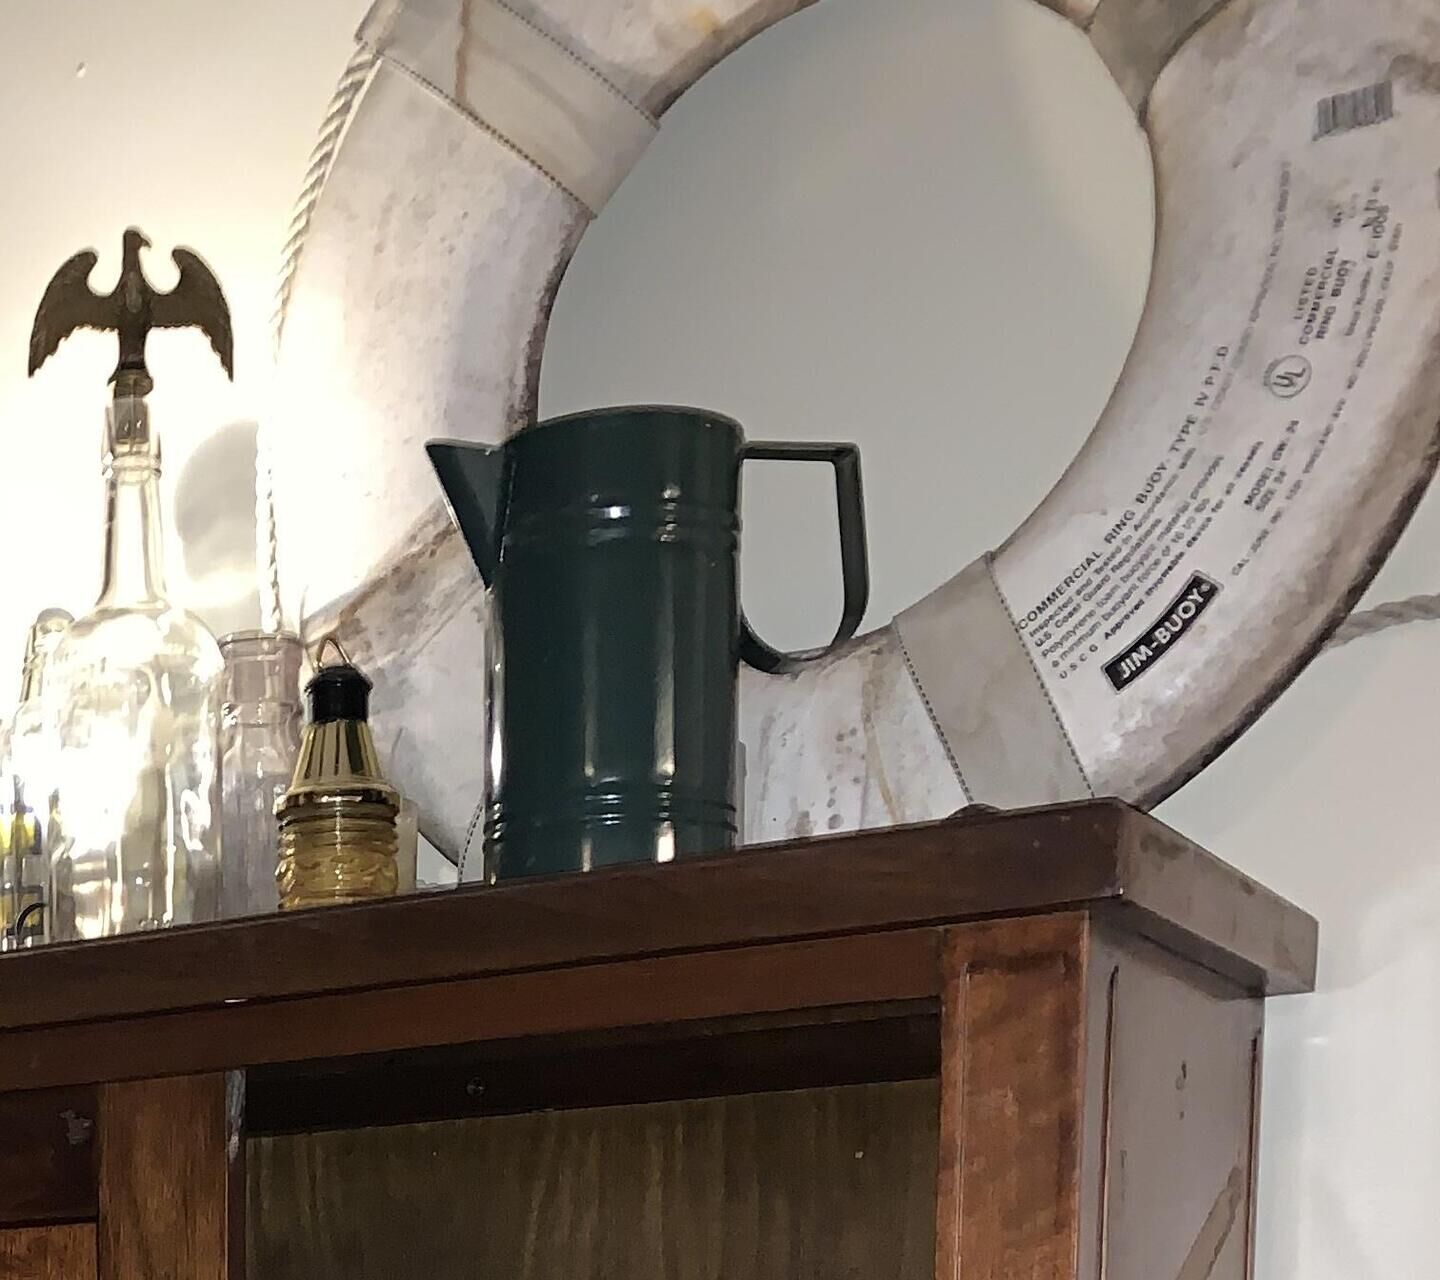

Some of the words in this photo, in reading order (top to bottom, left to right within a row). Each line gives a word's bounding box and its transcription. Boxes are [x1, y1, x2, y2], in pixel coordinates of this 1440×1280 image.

[1299, 248, 1339, 345] COMMERCIAL
[1316, 305, 1336, 339] RING
[1017, 551, 1103, 631] COMMERCIAL
[1104, 509, 1136, 544] RING
[1135, 462, 1168, 503] BUOY
[1168, 414, 1199, 452] TYPE
[1244, 467, 1274, 506] MODEL
[1029, 596, 1074, 638] Inspected
[1075, 577, 1094, 596] and
[1093, 545, 1123, 576] Tested
[1133, 474, 1179, 532] Accordance
[1042, 609, 1097, 658] Polystyrene
[1120, 543, 1156, 584] buoyant
[1157, 500, 1191, 541] material
[1054, 602, 1082, 629] Coast
[1082, 574, 1111, 603] Guard
[1111, 518, 1162, 574] Regulations
[1103, 599, 1145, 641] Approved
[1145, 551, 1186, 597] throwable
[1186, 516, 1212, 548] device
[1060, 620, 1102, 662] minimum
[1101, 583, 1139, 621] buoyant
[1119, 585, 1205, 680] JIM-BUOY
